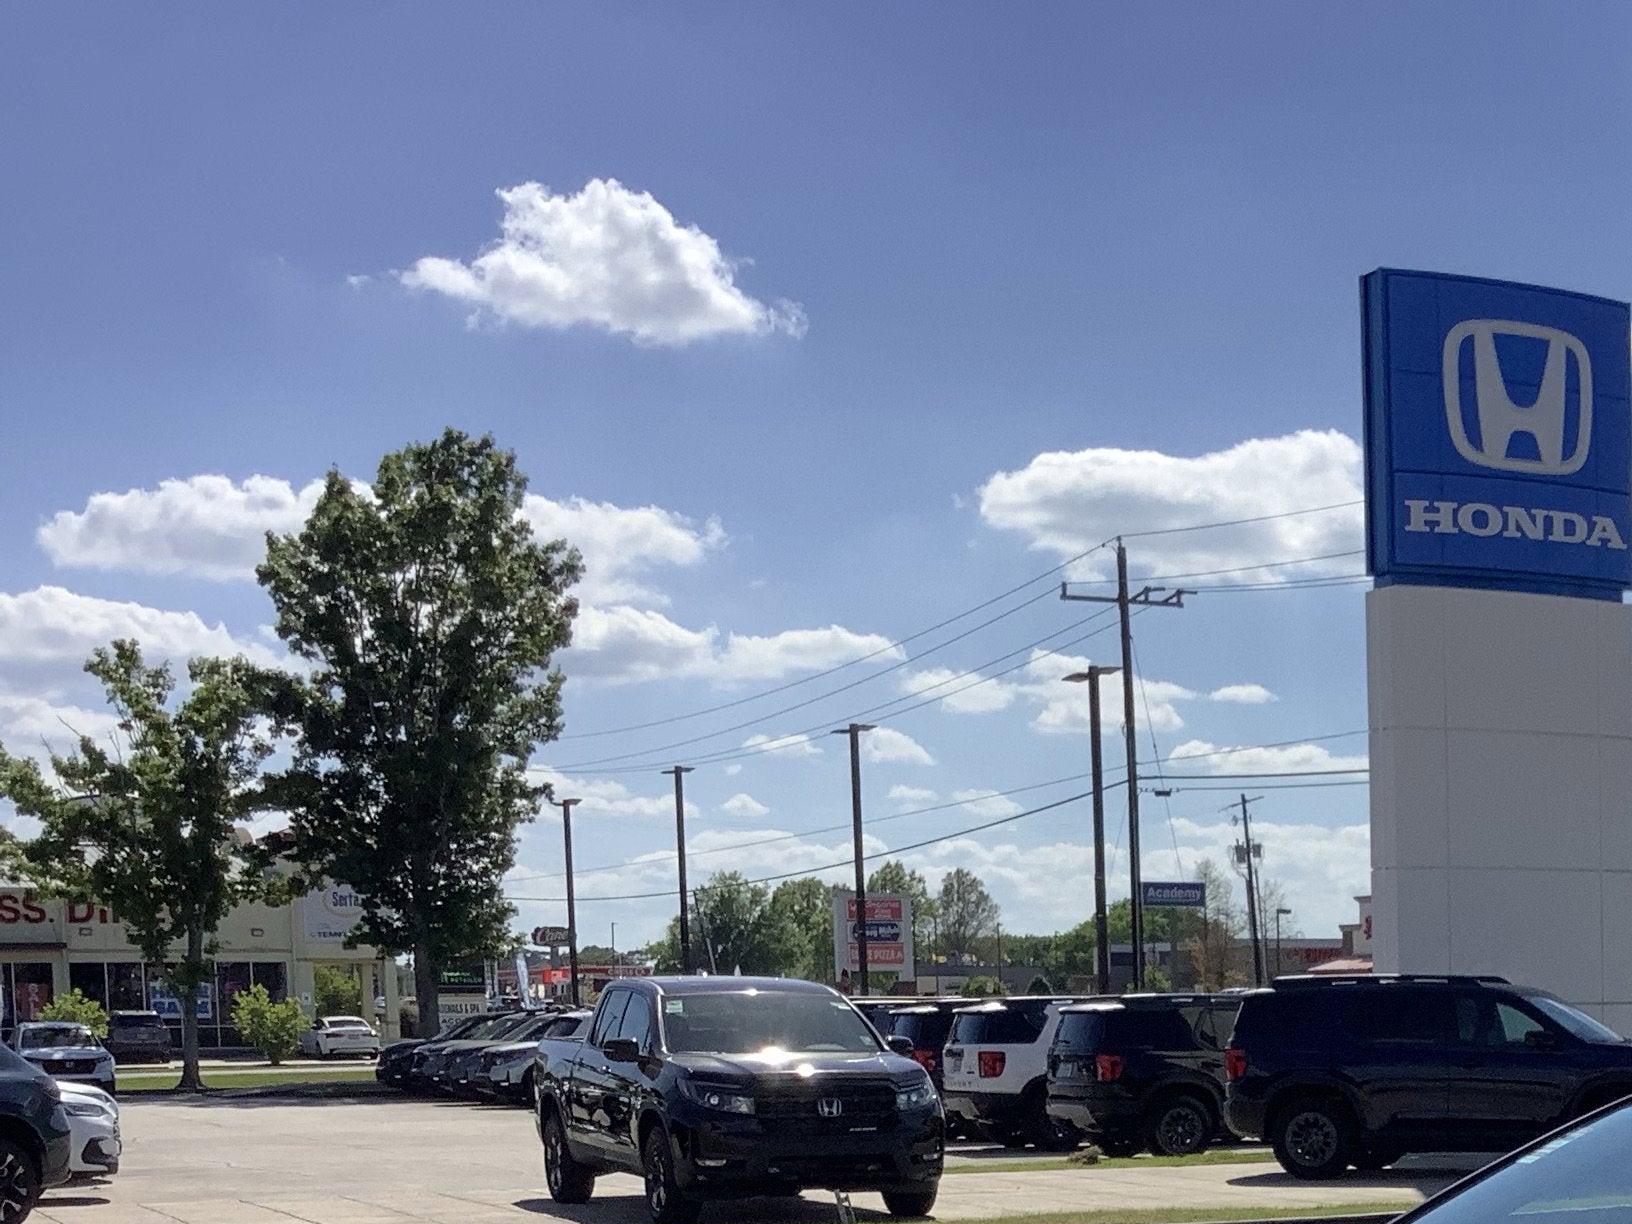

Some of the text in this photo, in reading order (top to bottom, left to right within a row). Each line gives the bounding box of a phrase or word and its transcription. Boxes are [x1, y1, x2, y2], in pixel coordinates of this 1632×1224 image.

[1403, 499, 1628, 550] HONDA
[332, 891, 359, 907] Serta
[1147, 886, 1201, 900] Academy
